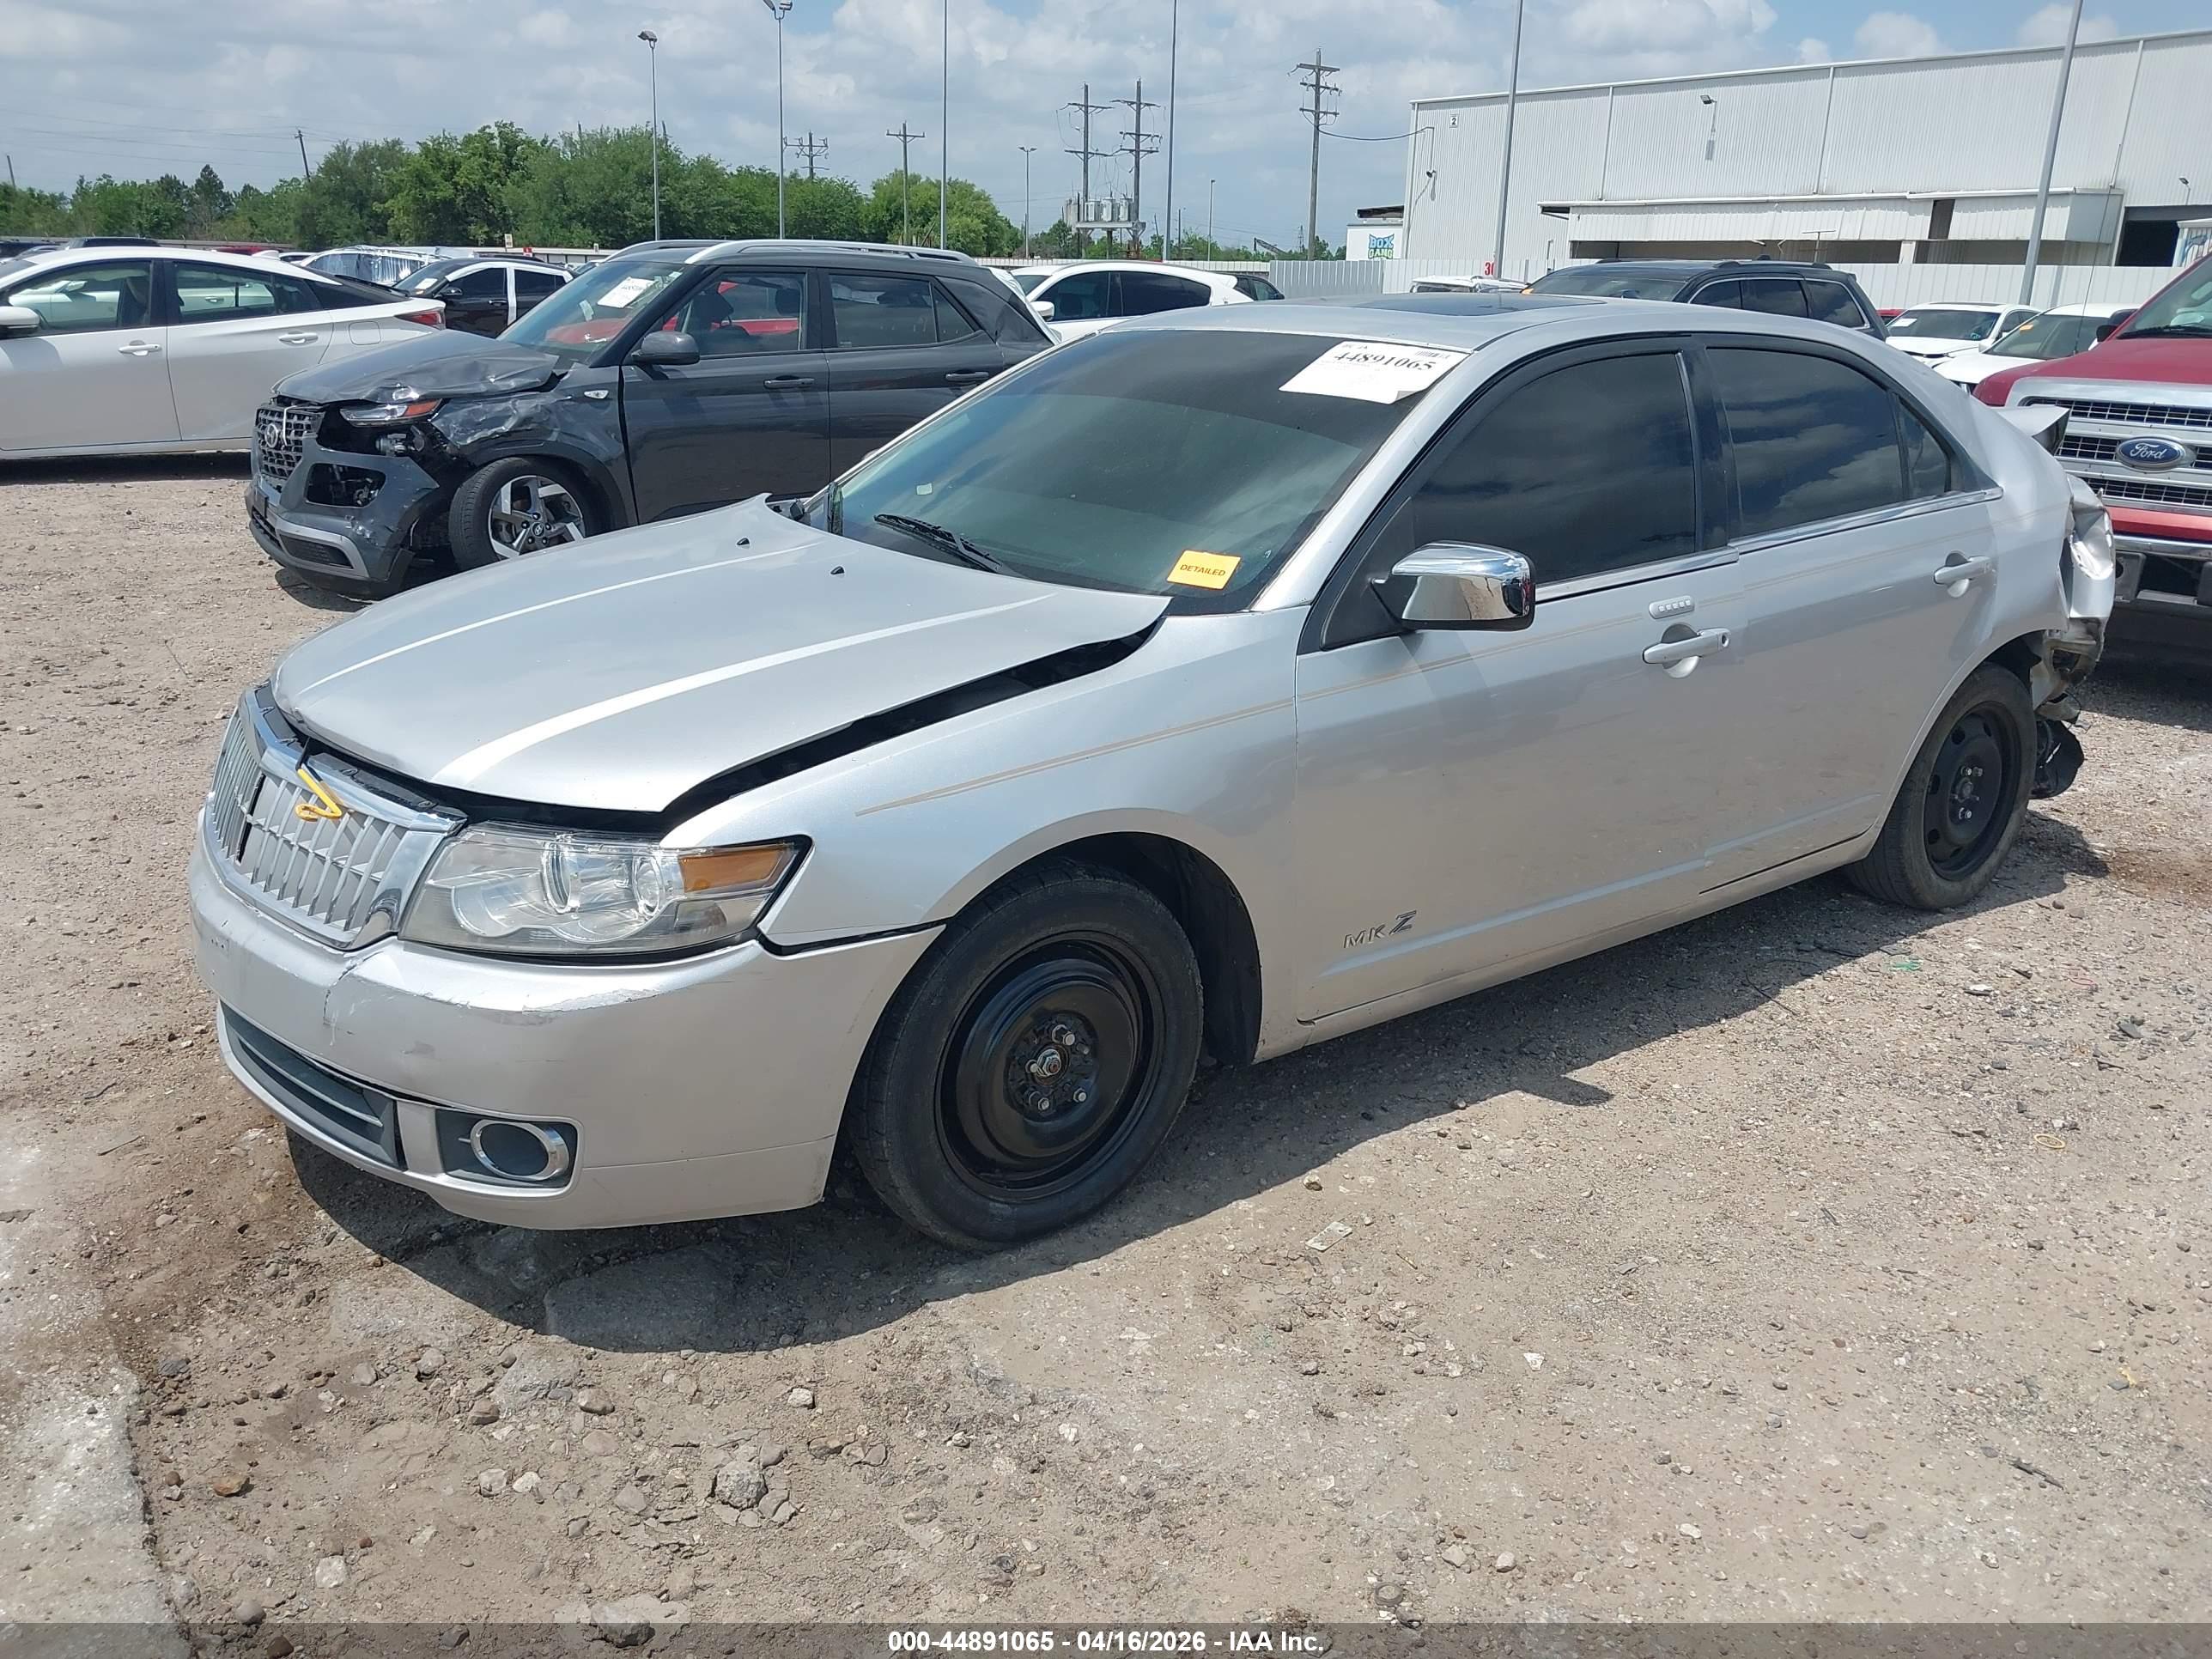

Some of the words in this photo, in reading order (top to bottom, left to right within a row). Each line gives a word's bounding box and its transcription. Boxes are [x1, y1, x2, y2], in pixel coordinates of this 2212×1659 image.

[1451, 117, 1457, 125] 2
[1369, 234, 1395, 248] BOX
[1334, 352, 1437, 370] 44891065
[2130, 443, 2166, 459] Ford
[1180, 564, 1226, 576] DETAILED
